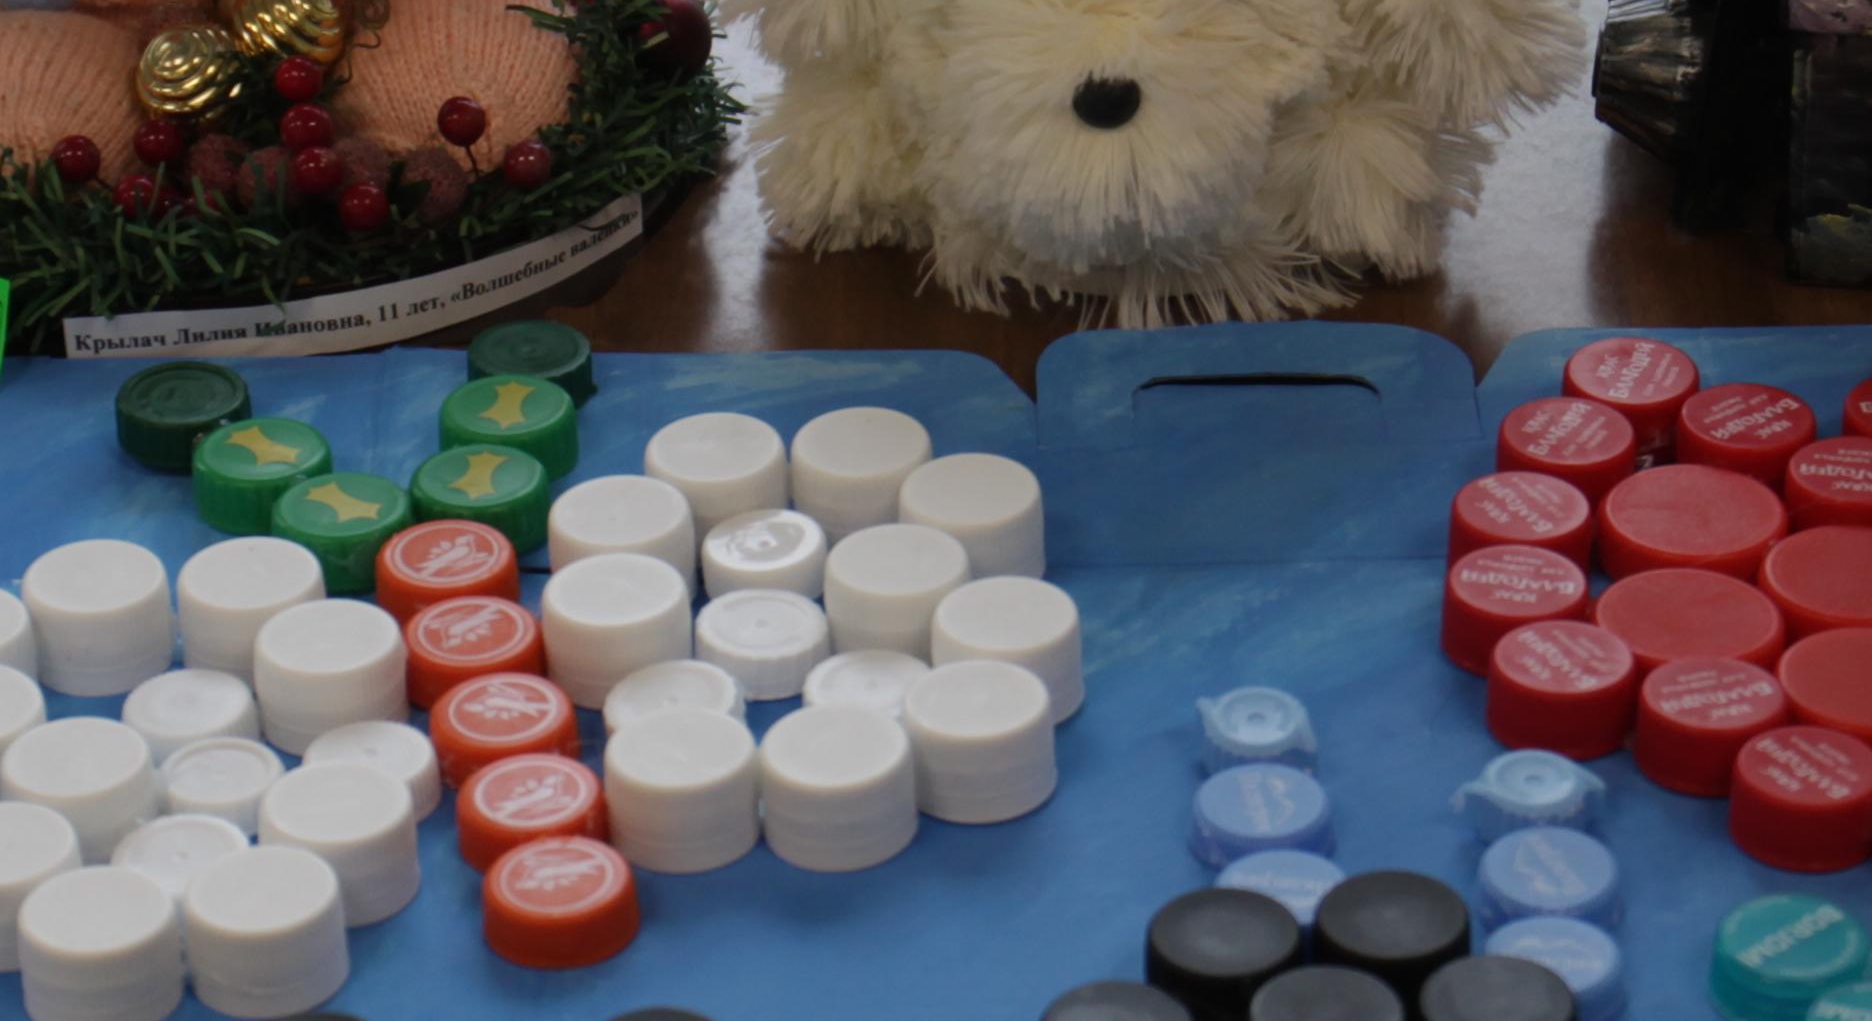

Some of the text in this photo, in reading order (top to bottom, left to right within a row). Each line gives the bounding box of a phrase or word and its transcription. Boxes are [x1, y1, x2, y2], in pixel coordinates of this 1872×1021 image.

[75, 334, 166, 354] Крылач
[173, 328, 247, 345] Лилия
[378, 304, 399, 322] 11
[406, 297, 445, 316] лет,
[450, 252, 566, 303] «Волшебные
